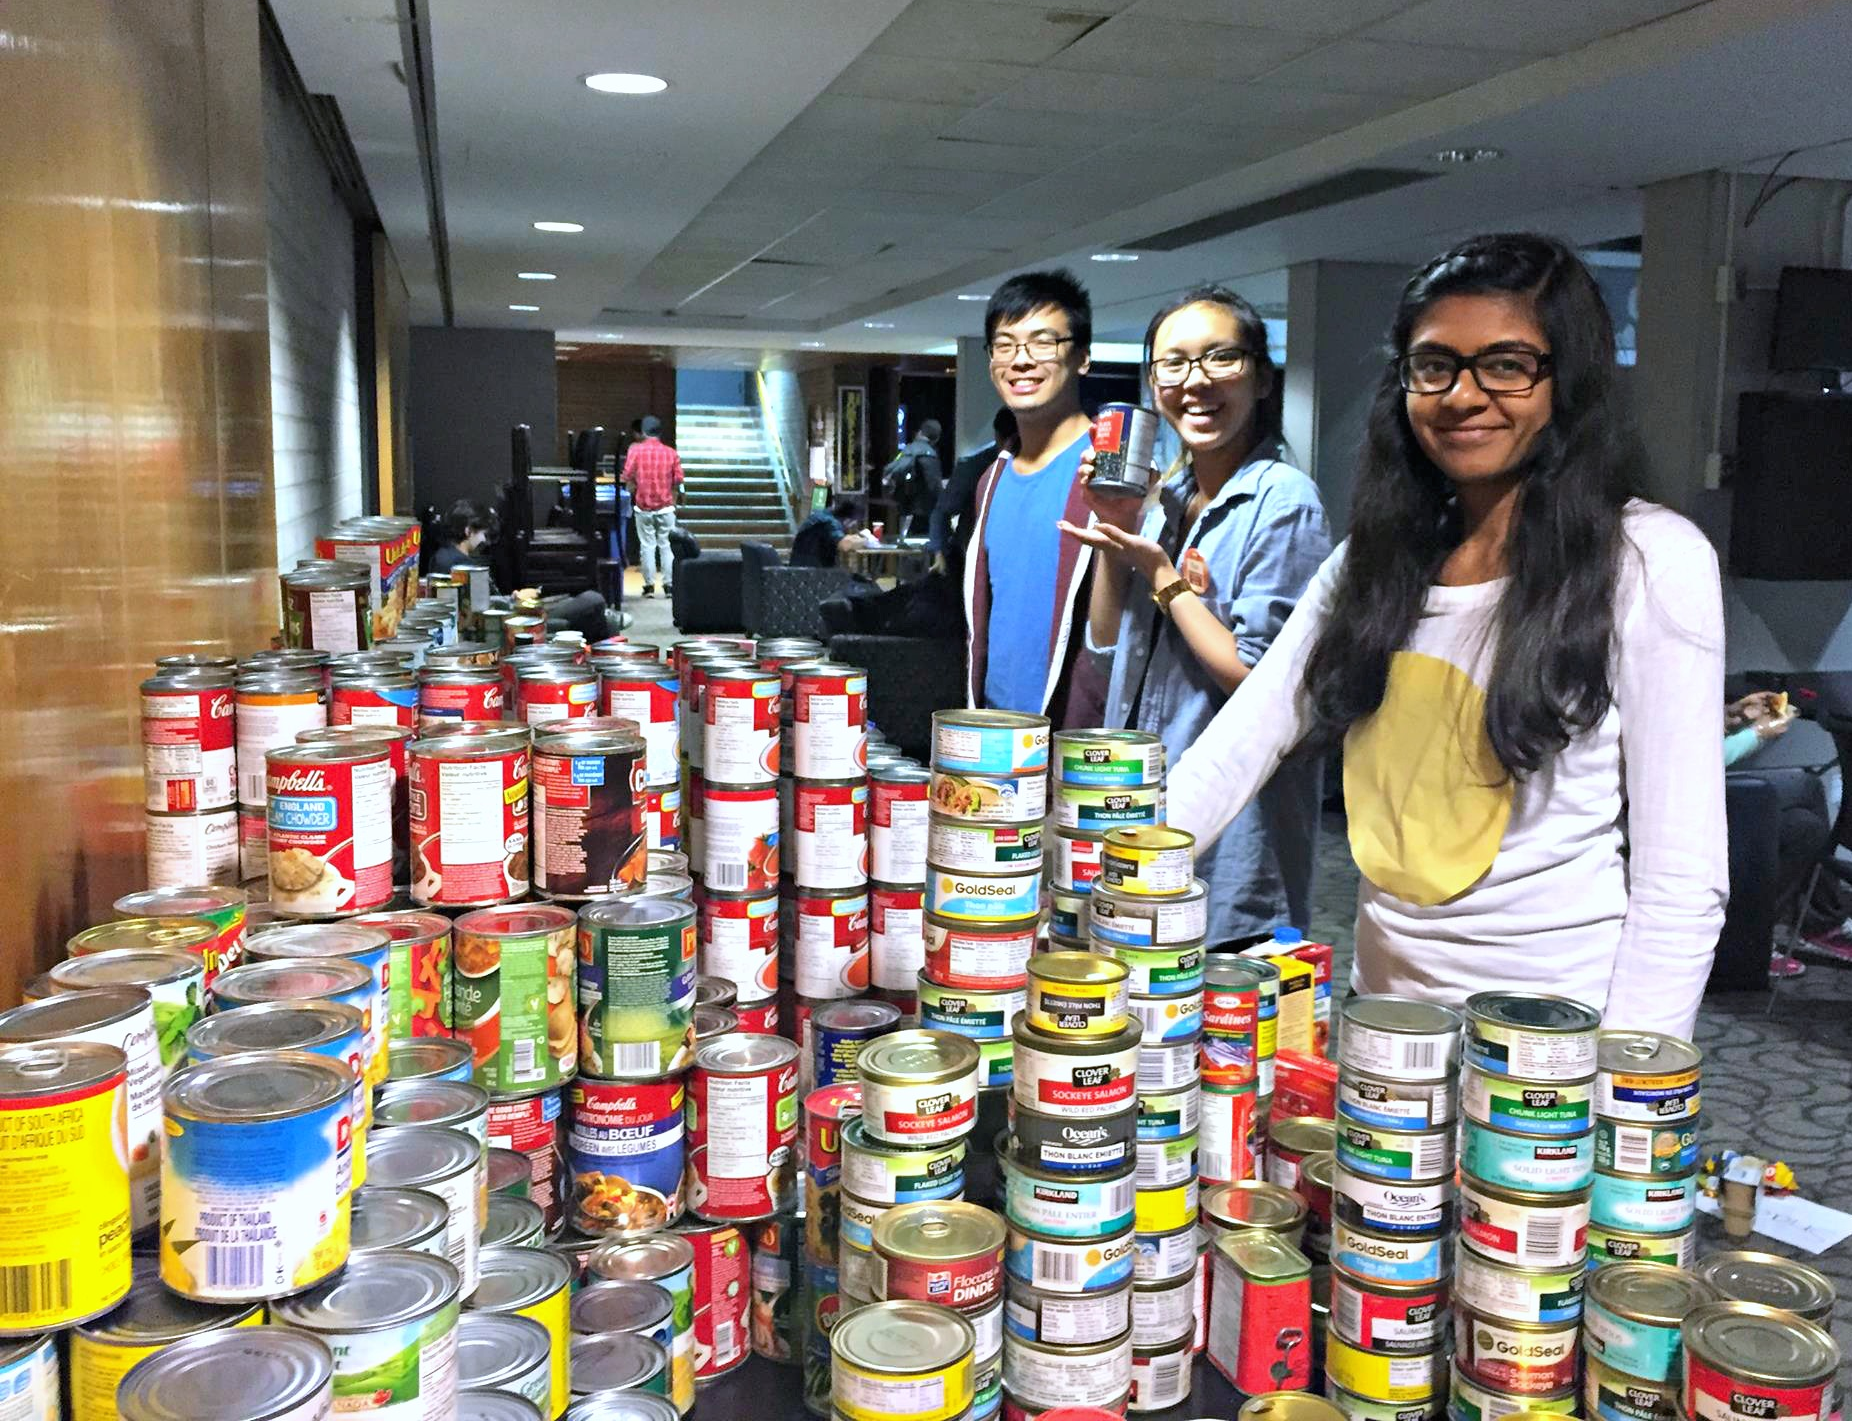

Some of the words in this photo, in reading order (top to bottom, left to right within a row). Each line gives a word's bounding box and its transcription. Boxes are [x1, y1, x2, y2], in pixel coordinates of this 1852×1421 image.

[1085, 749, 1110, 757] CLOVER
[280, 800, 326, 812] ENGLAND
[1106, 796, 1131, 805] CLOVER
[286, 811, 331, 826] CHOWDER
[955, 882, 1017, 896] GoldSeal
[1202, 1010, 1252, 1026] Sardines
[1075, 1067, 1111, 1078] CLOVER
[1082, 1076, 1103, 1086] LEAF
[1052, 1089, 1092, 1100] SOCKEYE
[1094, 1085, 1128, 1099] SALMON
[1525, 1092, 1556, 1100] CLOVER
[918, 1095, 951, 1107] CLOVER
[1531, 1099, 1551, 1107] LEAF
[925, 1104, 944, 1114] LEAF
[1508, 1107, 1536, 1117] CHUNK
[1536, 1110, 1559, 1119] LIGHT
[1559, 1110, 1577, 1118] TUNA
[28, 1110, 56, 1130] SOUTH
[58, 1106, 84, 1126] AFRICA
[898, 1119, 936, 1130] SOCKEYE
[937, 1109, 969, 1124] SALMON
[608, 1124, 655, 1140] BŒUF
[1062, 1125, 1109, 1140] Ocean's
[1043, 1149, 1065, 1159] THON
[1067, 1150, 1094, 1160] BLANC
[1537, 1146, 1577, 1156] KIRKLAND
[1035, 1187, 1078, 1199] KIRKLAND
[1383, 1189, 1427, 1203] Ocean's
[199, 1211, 227, 1227] PRODUCT
[238, 1210, 271, 1226] THAILAND
[1366, 1208, 1388, 1220] THON
[1389, 1212, 1415, 1223] BLANC
[1416, 1211, 1440, 1222] ENTIER
[1346, 1236, 1409, 1260] GoldSeal
[953, 1270, 994, 1288] Flocons
[953, 1277, 996, 1302] DINDE
[1496, 1341, 1565, 1357] GoldSeal
[1628, 1388, 1661, 1401] CLOVER
[1733, 1393, 1776, 1408] CLOVER
[1634, 1398, 1654, 1408] LEAF
[1742, 1403, 1766, 1417] LEAF
